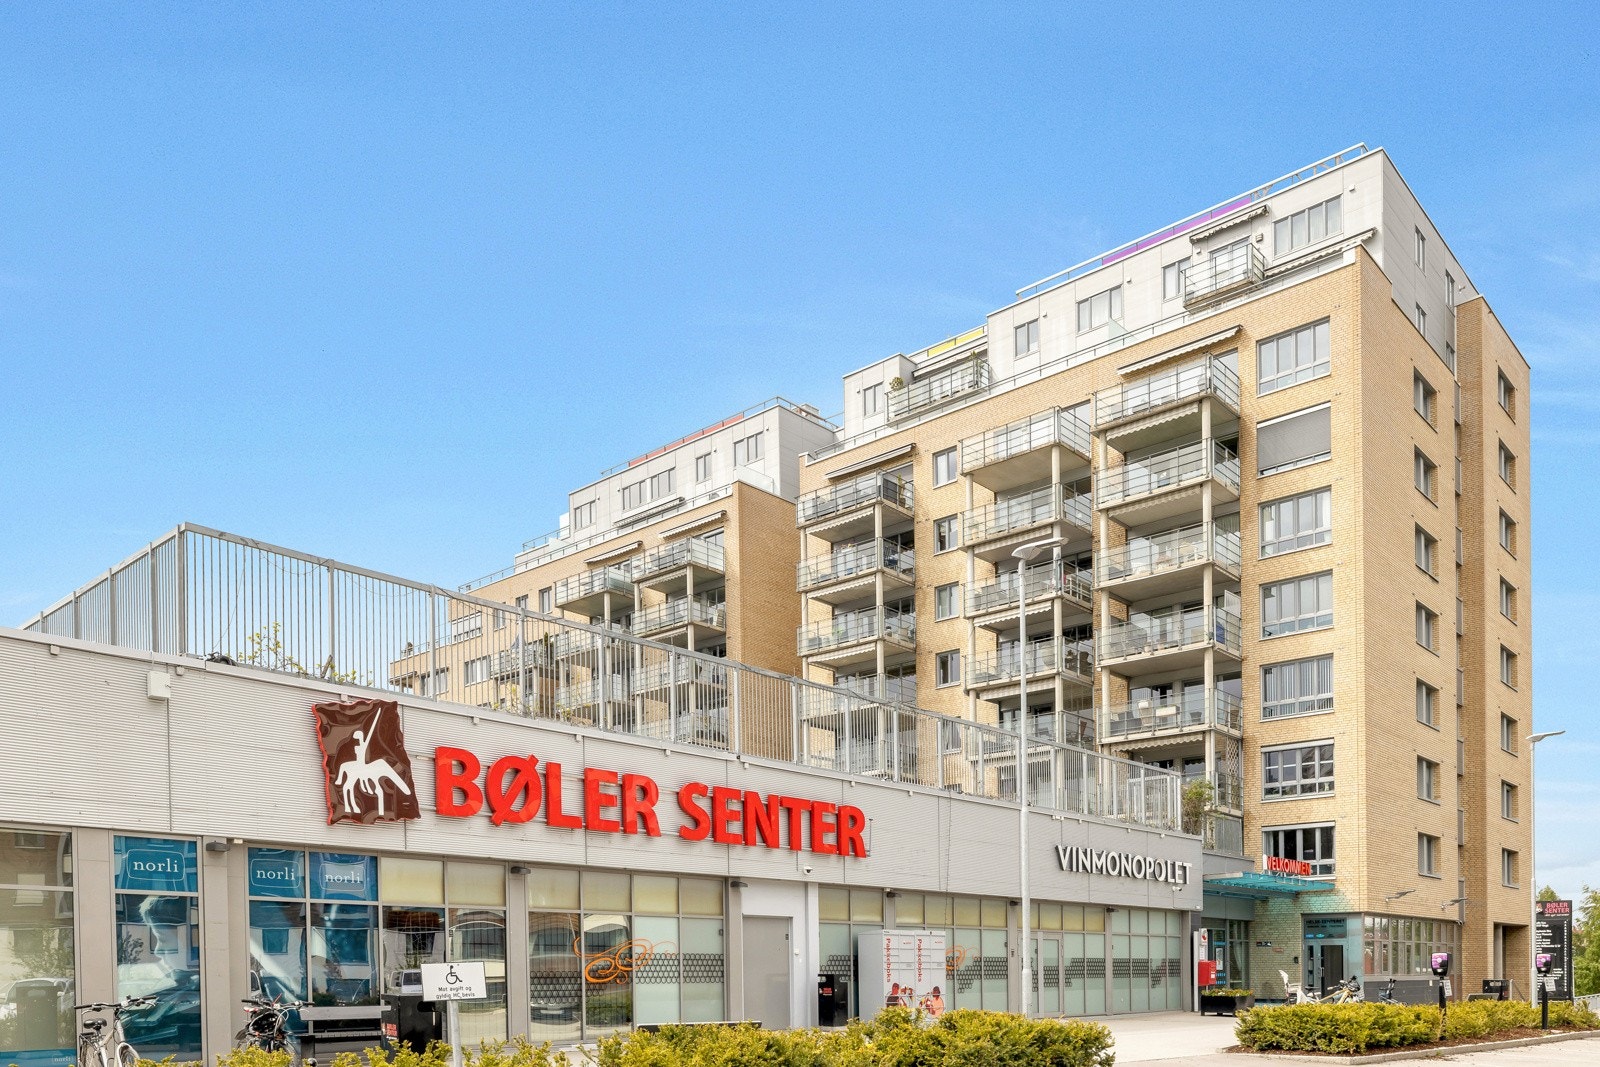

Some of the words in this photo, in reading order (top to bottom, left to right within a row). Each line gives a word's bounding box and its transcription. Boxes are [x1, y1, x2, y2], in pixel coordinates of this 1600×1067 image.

[434, 746, 662, 838] BØLER
[677, 781, 867, 859] SENTER
[133, 858, 179, 873] norli
[256, 867, 296, 881] norli
[1055, 845, 1193, 885] VINMONOPOLET
[1266, 855, 1312, 876] VELKOMMEN
[325, 871, 361, 884] norli
